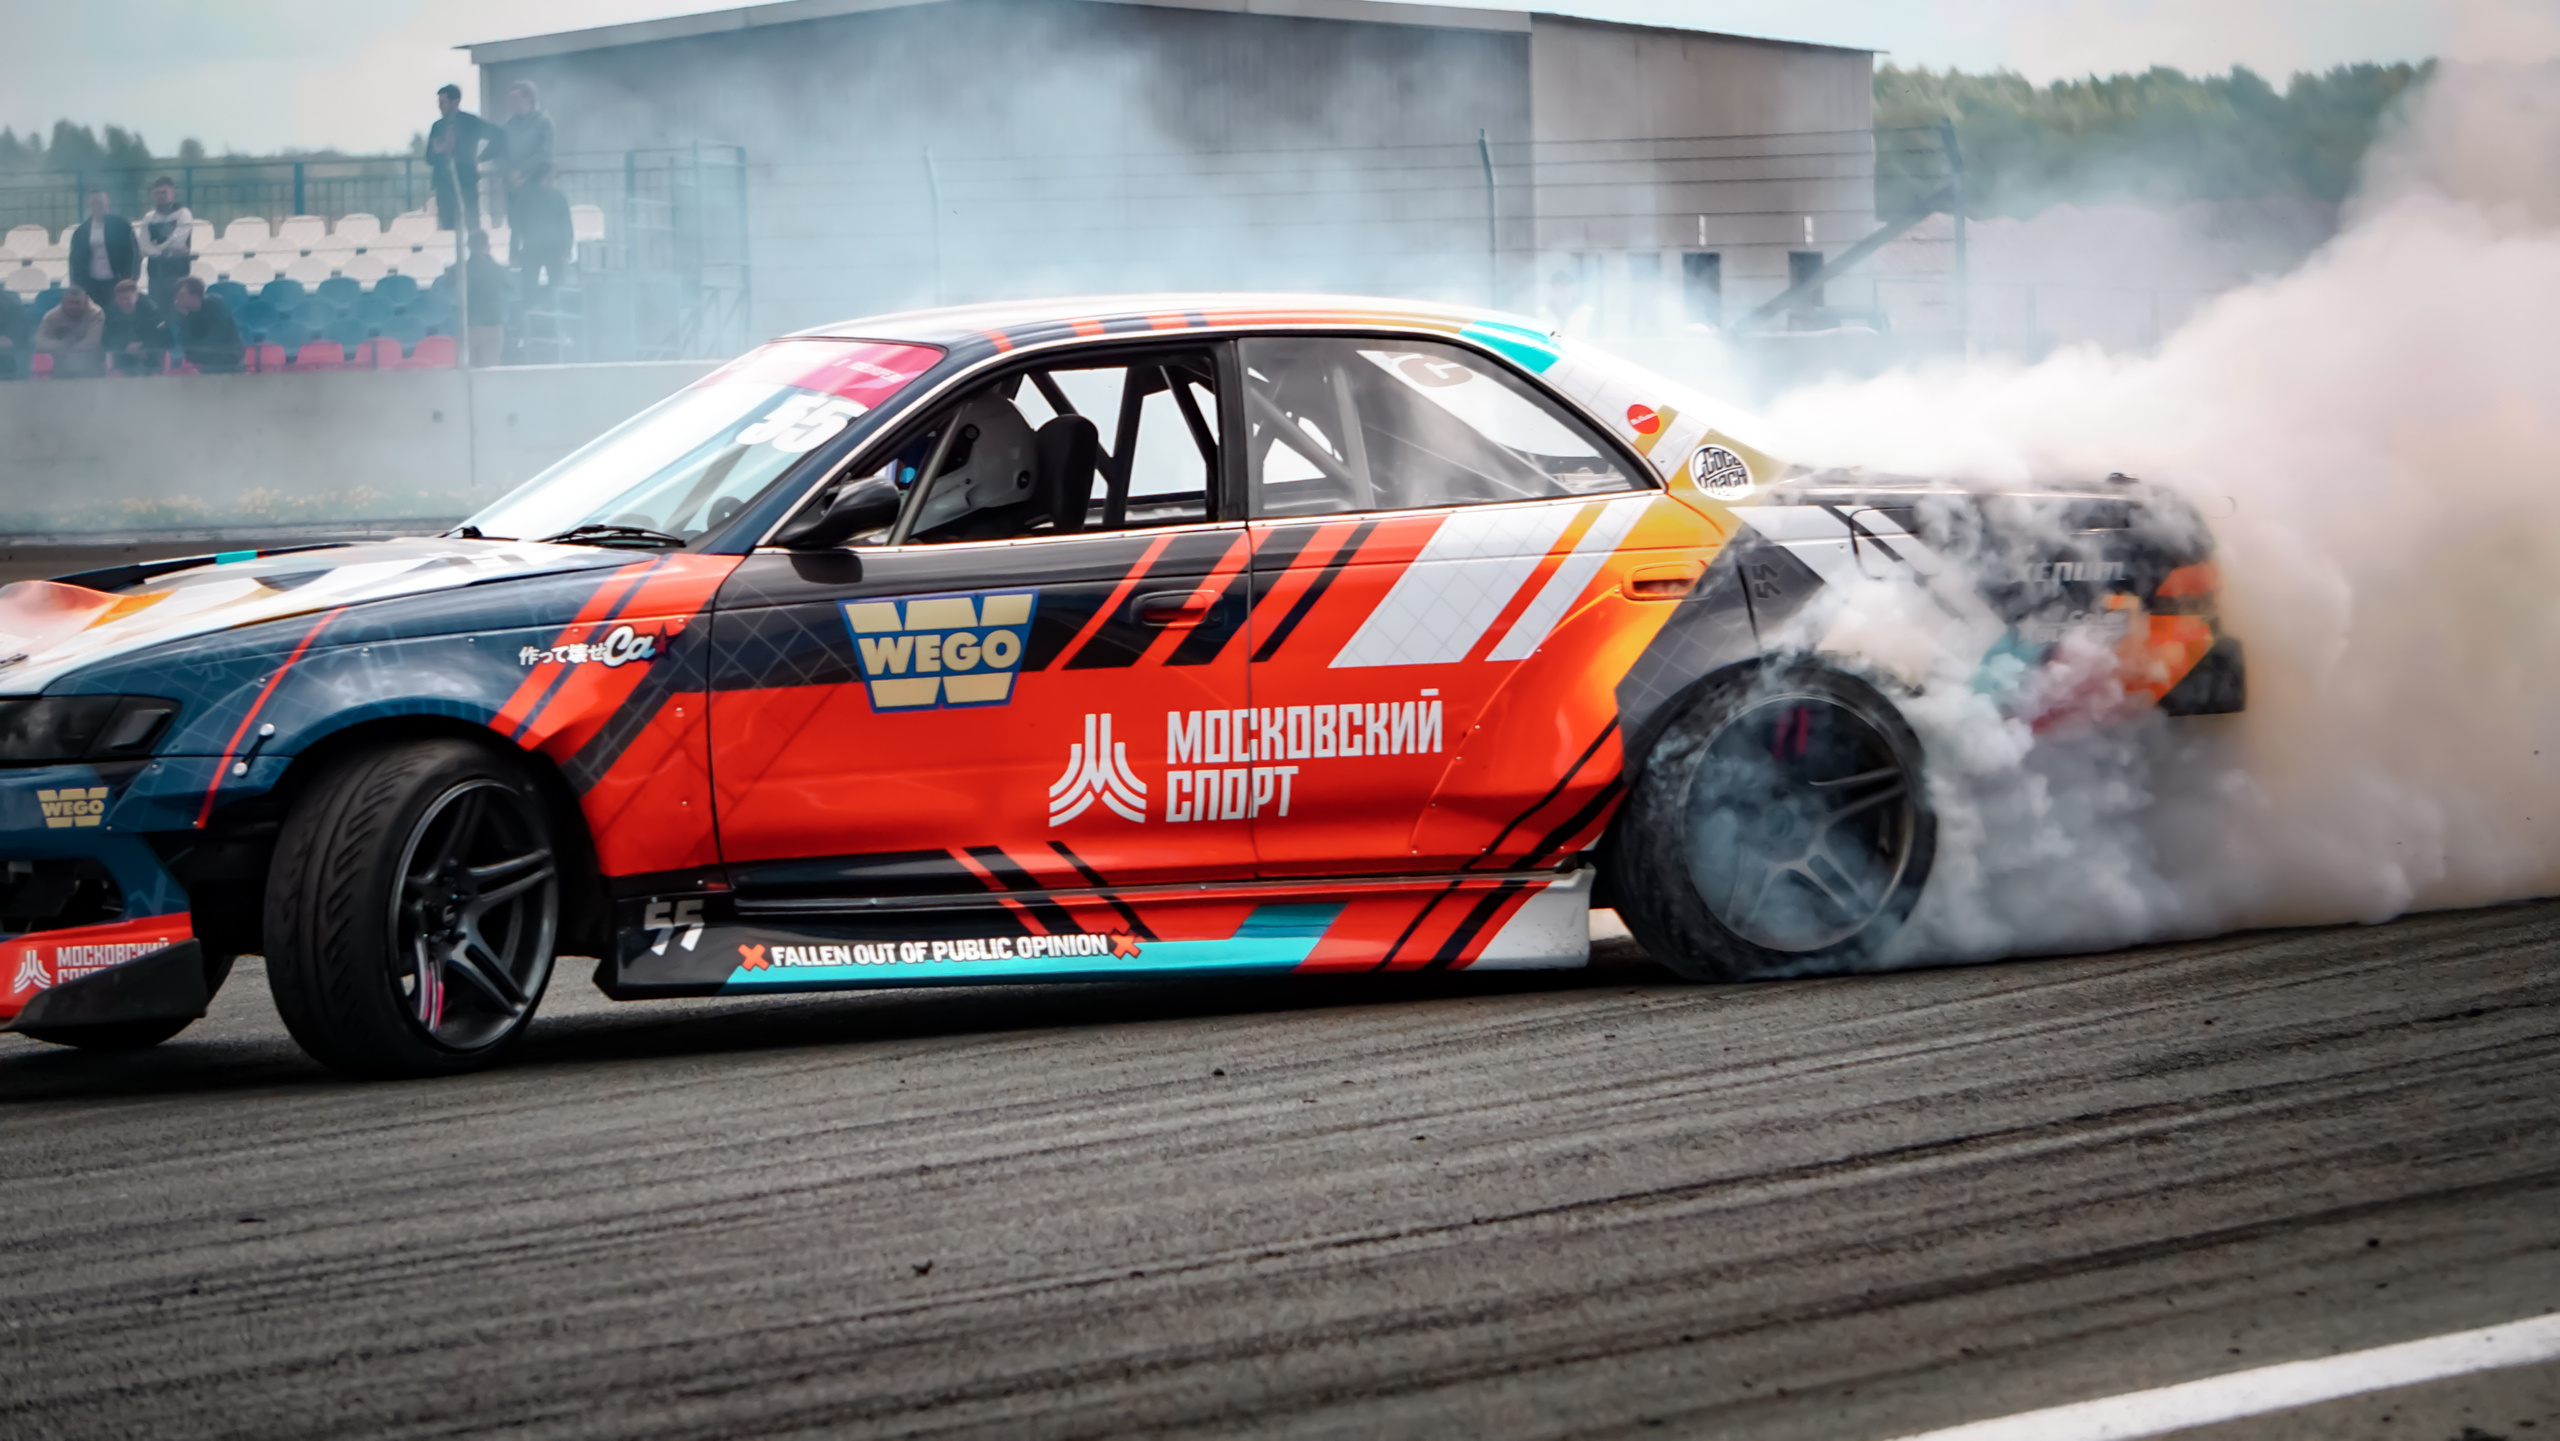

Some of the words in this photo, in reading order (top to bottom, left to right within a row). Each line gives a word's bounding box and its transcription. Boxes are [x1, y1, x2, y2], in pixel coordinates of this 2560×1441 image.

[736, 394, 869, 453] 55
[858, 629, 1022, 675] WEGO
[1167, 688, 1443, 764] МОСКОВСКИЙ
[41, 800, 105, 817] WEGO
[1166, 766, 1299, 822] СПОРТ
[771, 945, 853, 968] FALLEN
[854, 943, 897, 966] OUT
[899, 941, 929, 964] OF
[931, 937, 1013, 963] PUBLIC
[1016, 934, 1109, 958] OPINION
